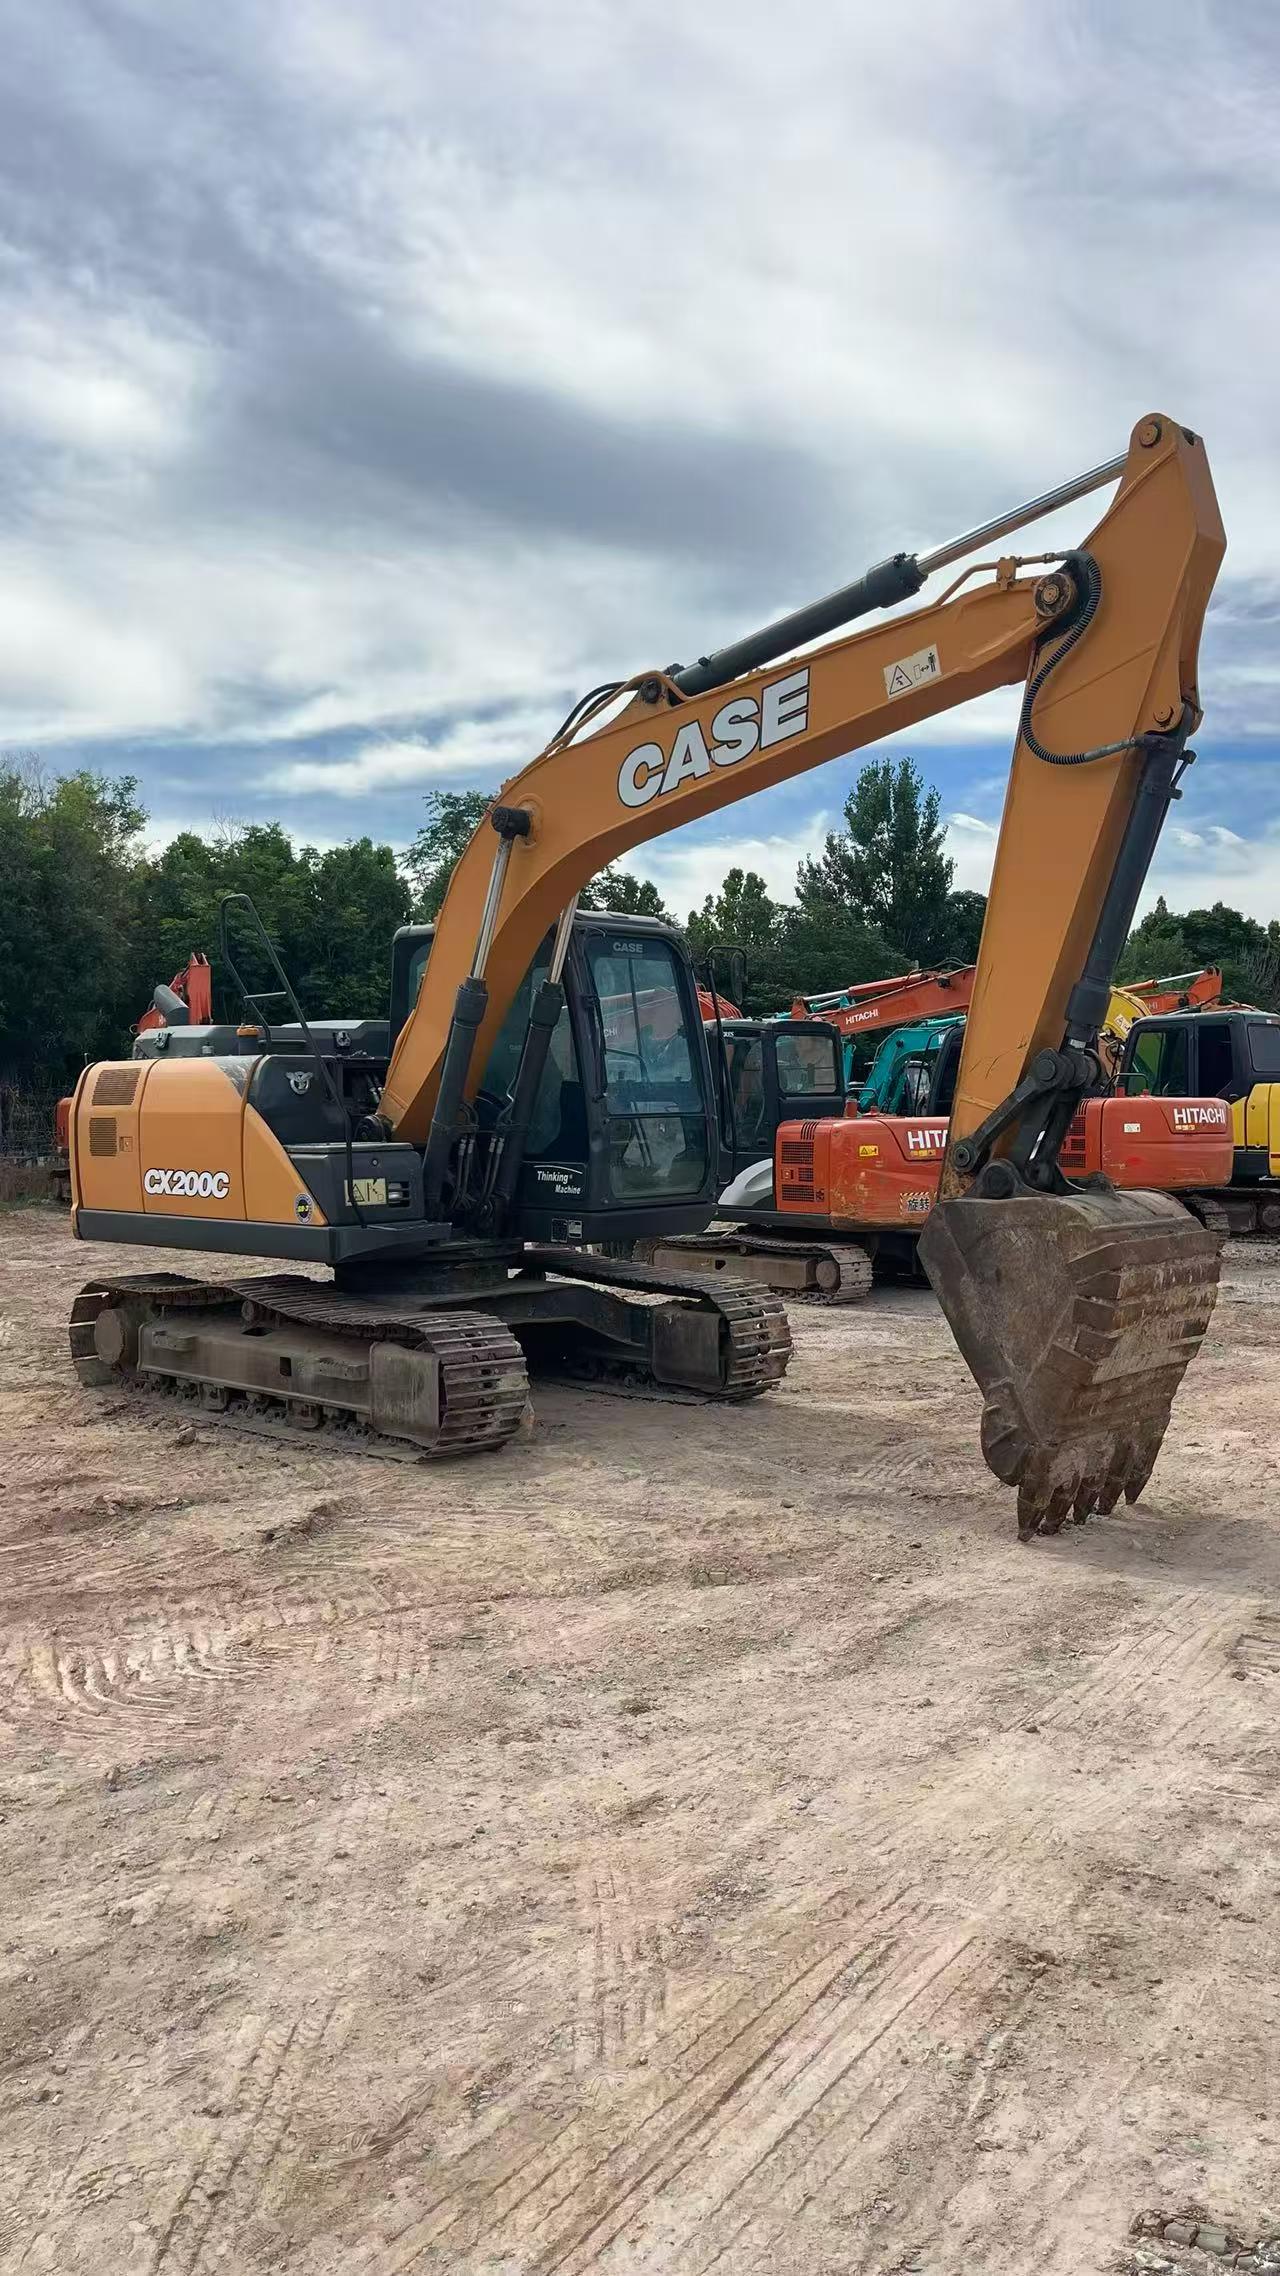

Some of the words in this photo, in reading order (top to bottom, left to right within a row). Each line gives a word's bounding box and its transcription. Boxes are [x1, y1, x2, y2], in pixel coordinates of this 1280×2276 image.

[617, 666, 810, 808] CASE
[613, 942, 643, 953] CASE
[845, 1008, 879, 1025] HITACHI
[1173, 1108, 1225, 1124] HITACHI
[144, 1168, 230, 1200] CX200C
[537, 1170, 569, 1184] Thinking
[554, 1184, 581, 1195] Machine
